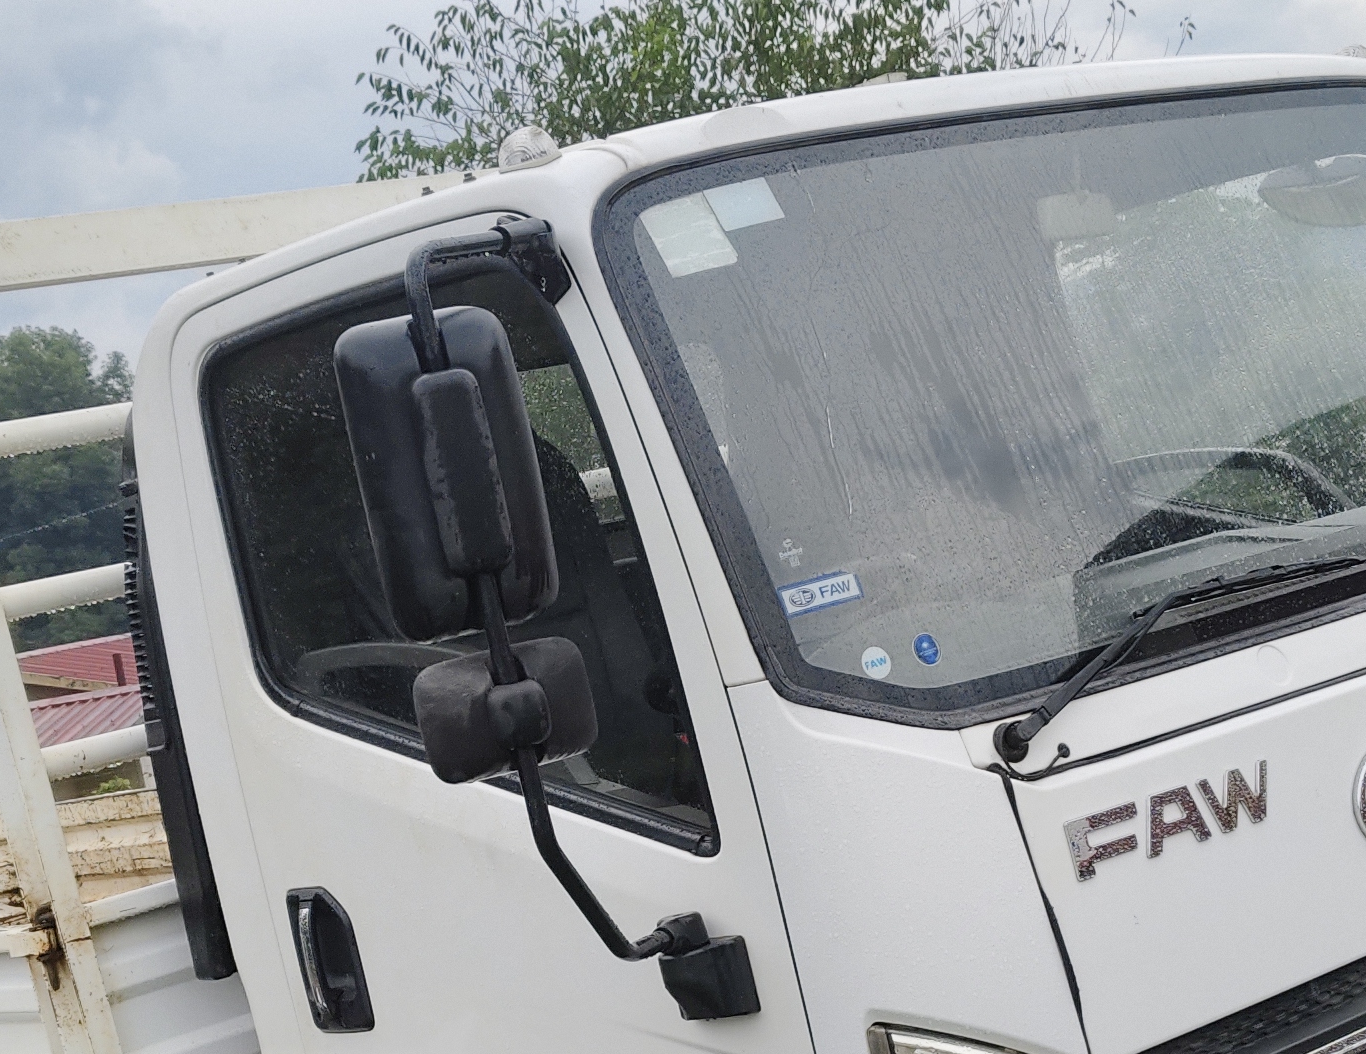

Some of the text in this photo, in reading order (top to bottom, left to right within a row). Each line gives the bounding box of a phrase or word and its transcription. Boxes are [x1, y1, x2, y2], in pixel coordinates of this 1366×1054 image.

[819, 579, 851, 598] FAW
[864, 655, 888, 671] FAW
[1063, 759, 1268, 883] FAW
